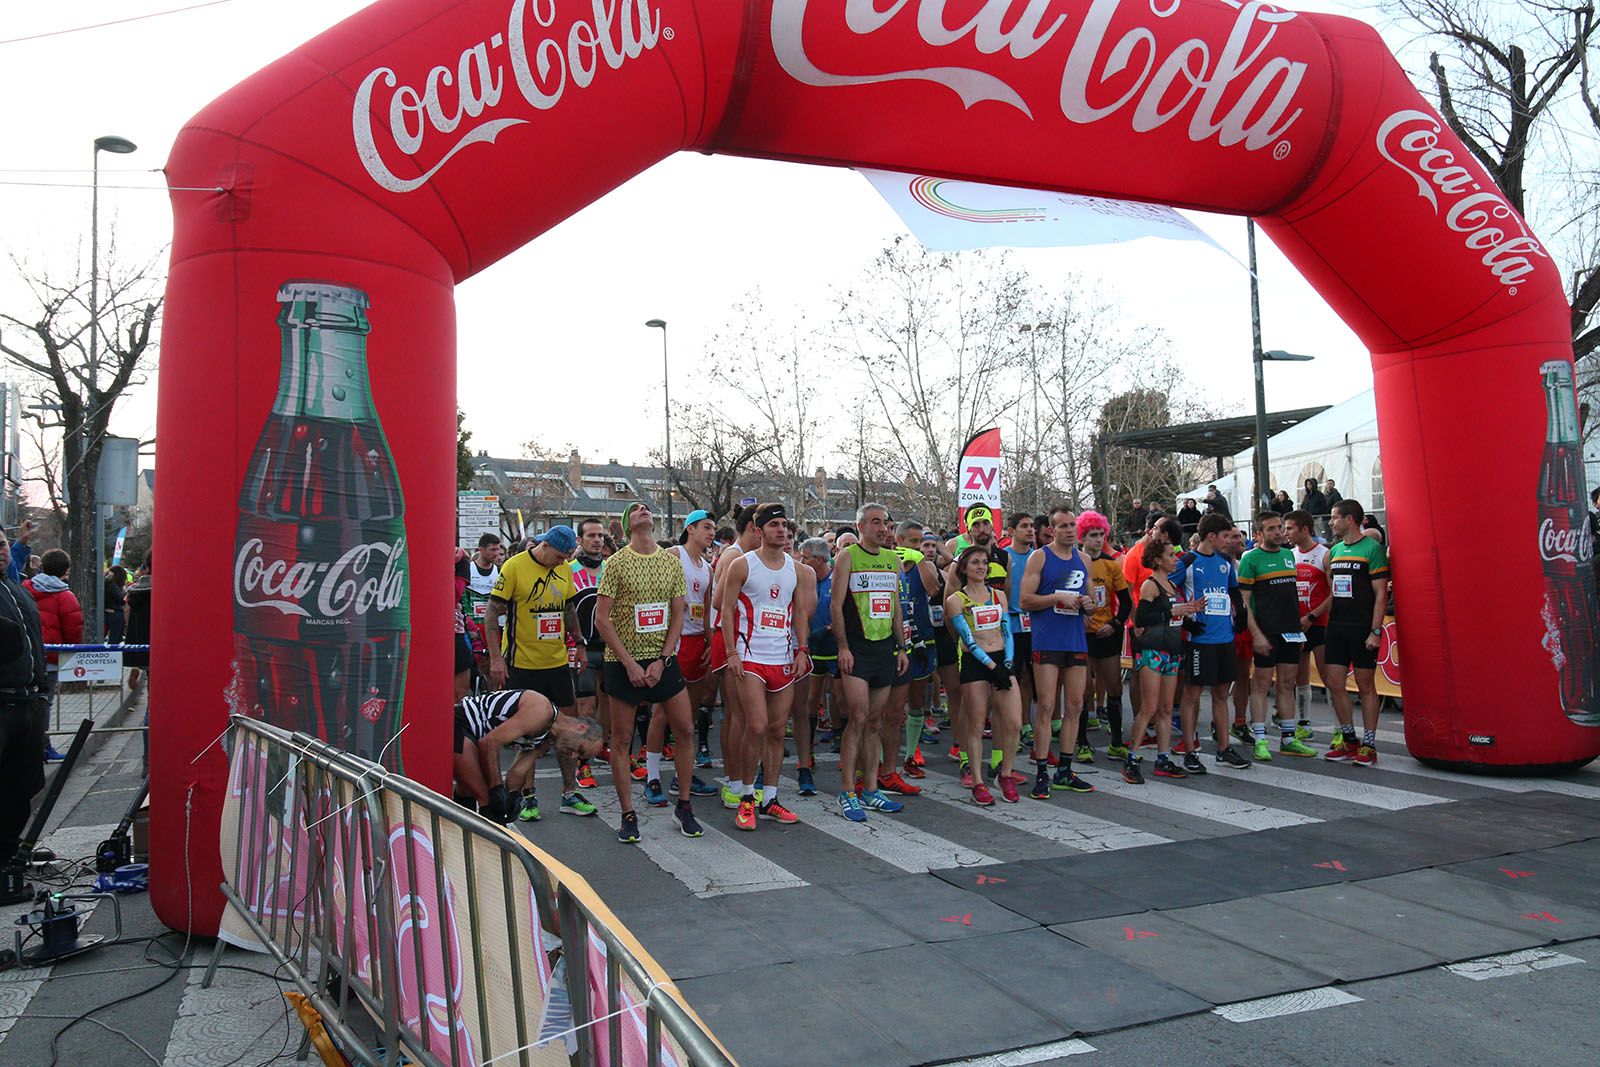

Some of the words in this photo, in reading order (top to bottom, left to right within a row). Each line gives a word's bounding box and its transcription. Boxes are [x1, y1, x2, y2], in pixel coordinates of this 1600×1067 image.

[352, 0, 660, 192] Coca-Cola
[1376, 109, 1547, 285] Coca-Cola
[961, 493, 985, 501] ZONA
[234, 537, 406, 617] Coca-Cola
[764, 612, 784, 621] XAVIER
[306, 618, 335, 626] MARCAS
[647, 617, 657, 625] 81
[768, 619, 778, 627] 21
